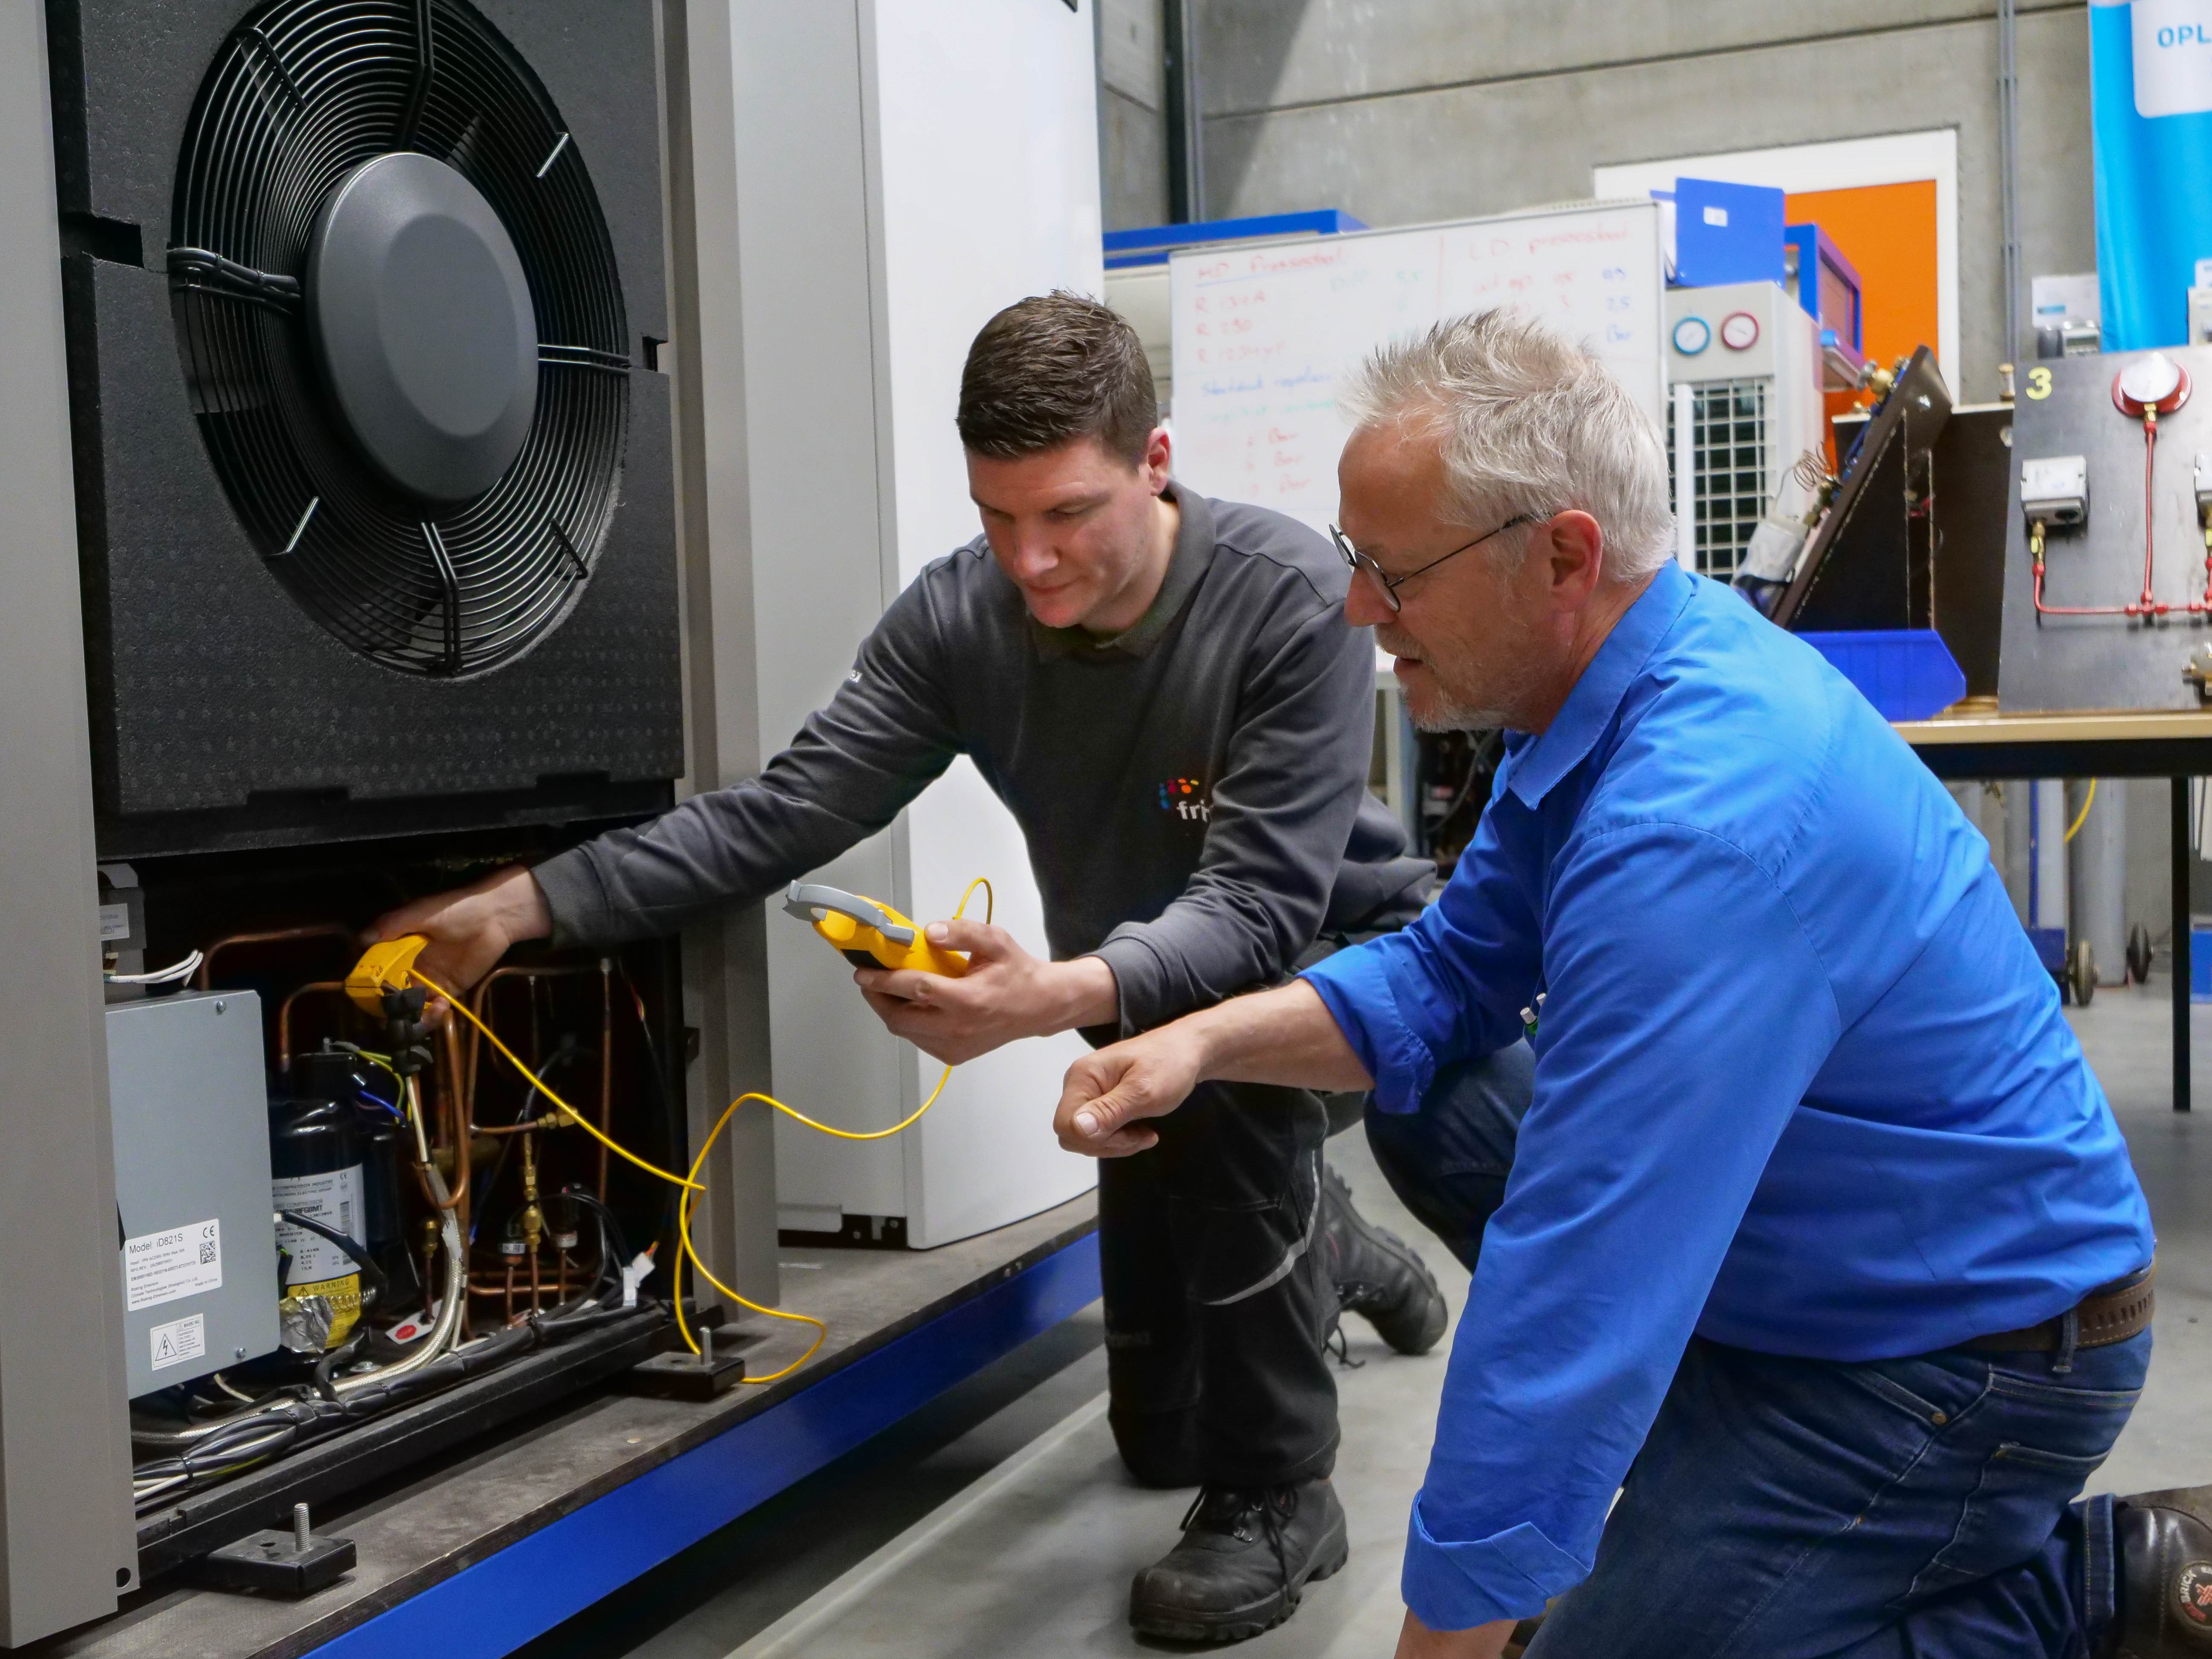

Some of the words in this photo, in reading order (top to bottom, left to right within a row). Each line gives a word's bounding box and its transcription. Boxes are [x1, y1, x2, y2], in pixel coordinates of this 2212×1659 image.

[2026, 367, 2052, 400] 3
[1176, 799, 1211, 822] fri
[129, 1241, 152, 1254] Model
[157, 1233, 183, 1248] iD821S
[313, 1278, 349, 1292] WARNING
